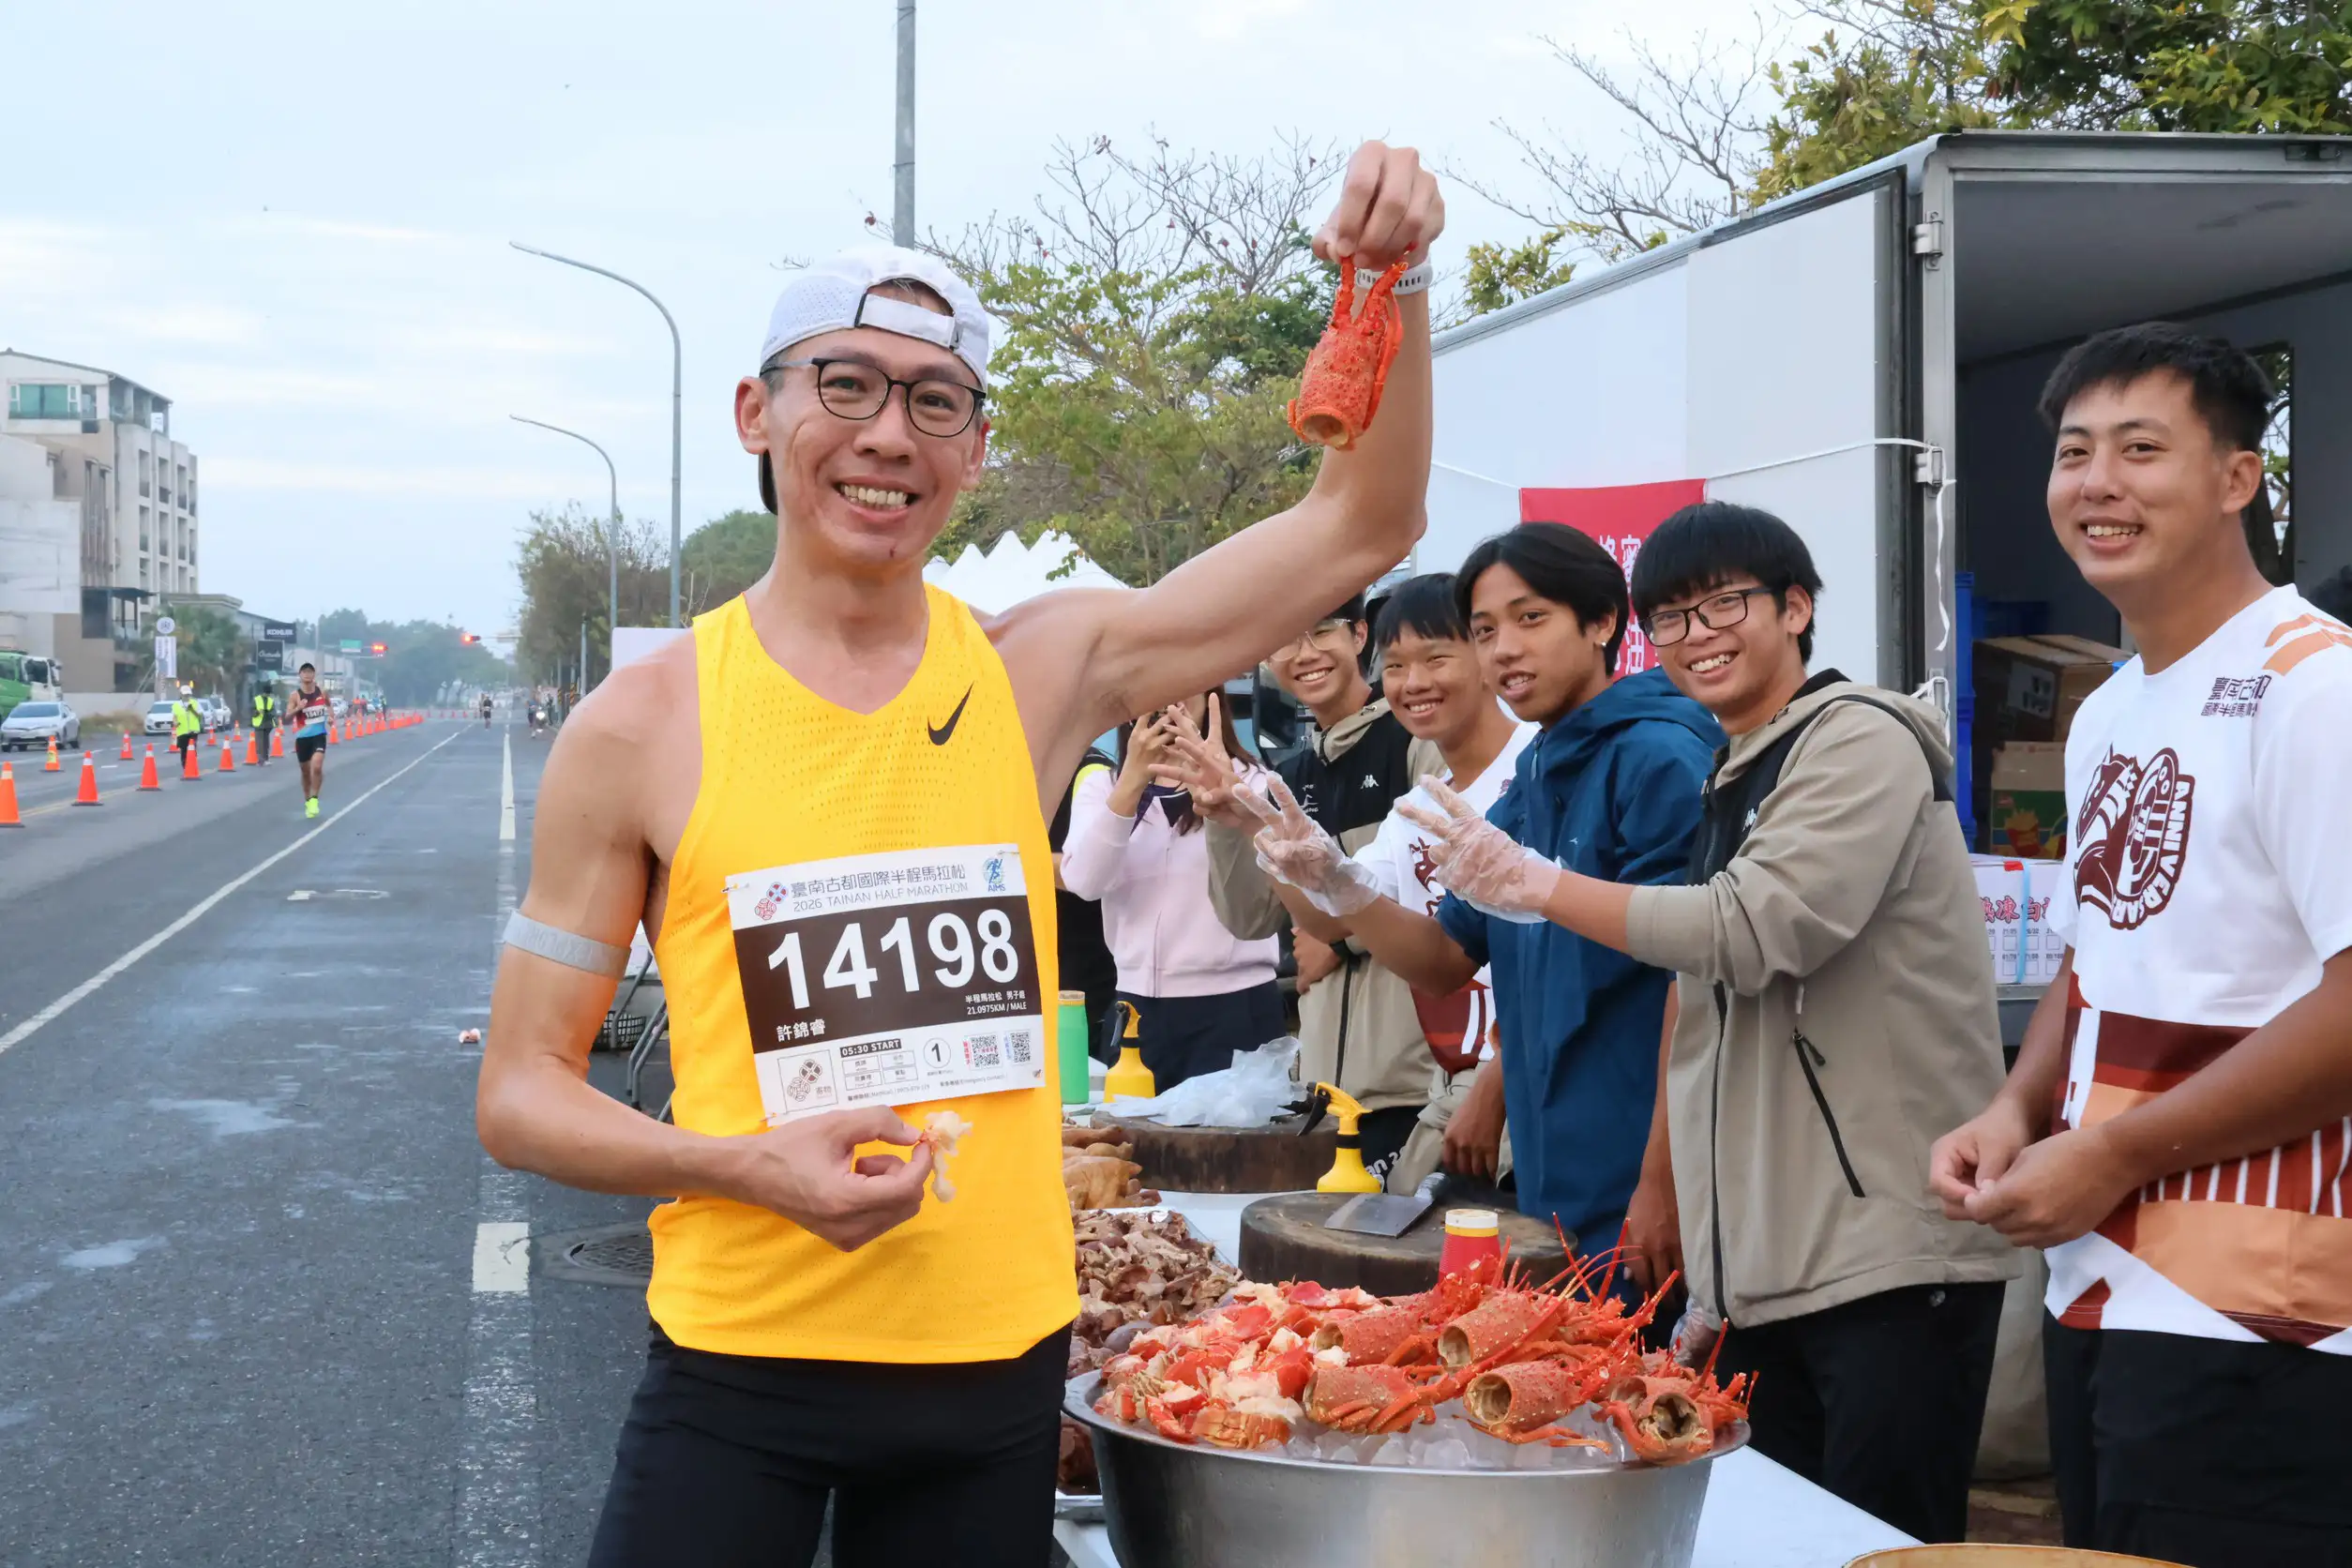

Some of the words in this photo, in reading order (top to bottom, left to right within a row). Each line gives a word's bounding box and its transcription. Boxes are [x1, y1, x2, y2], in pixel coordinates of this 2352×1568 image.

[791, 864, 966, 898] 臺南古都國際半程馬拉松
[988, 883, 1006, 892] AIMS
[793, 899, 822, 912] 2026
[828, 893, 872, 908] TAINAN
[875, 888, 904, 901] HALF
[906, 882, 969, 898] MARATHON
[768, 909, 1018, 1009] 14198
[965, 991, 1003, 1003] 半程馬拉松
[967, 1003, 1005, 1016] 21.0975KM
[1010, 1002, 1027, 1011] MALE
[776, 1018, 825, 1042] 許錦睿
[841, 1045, 868, 1057] 05:30
[870, 1039, 900, 1051] START
[930, 1043, 942, 1062] 1
